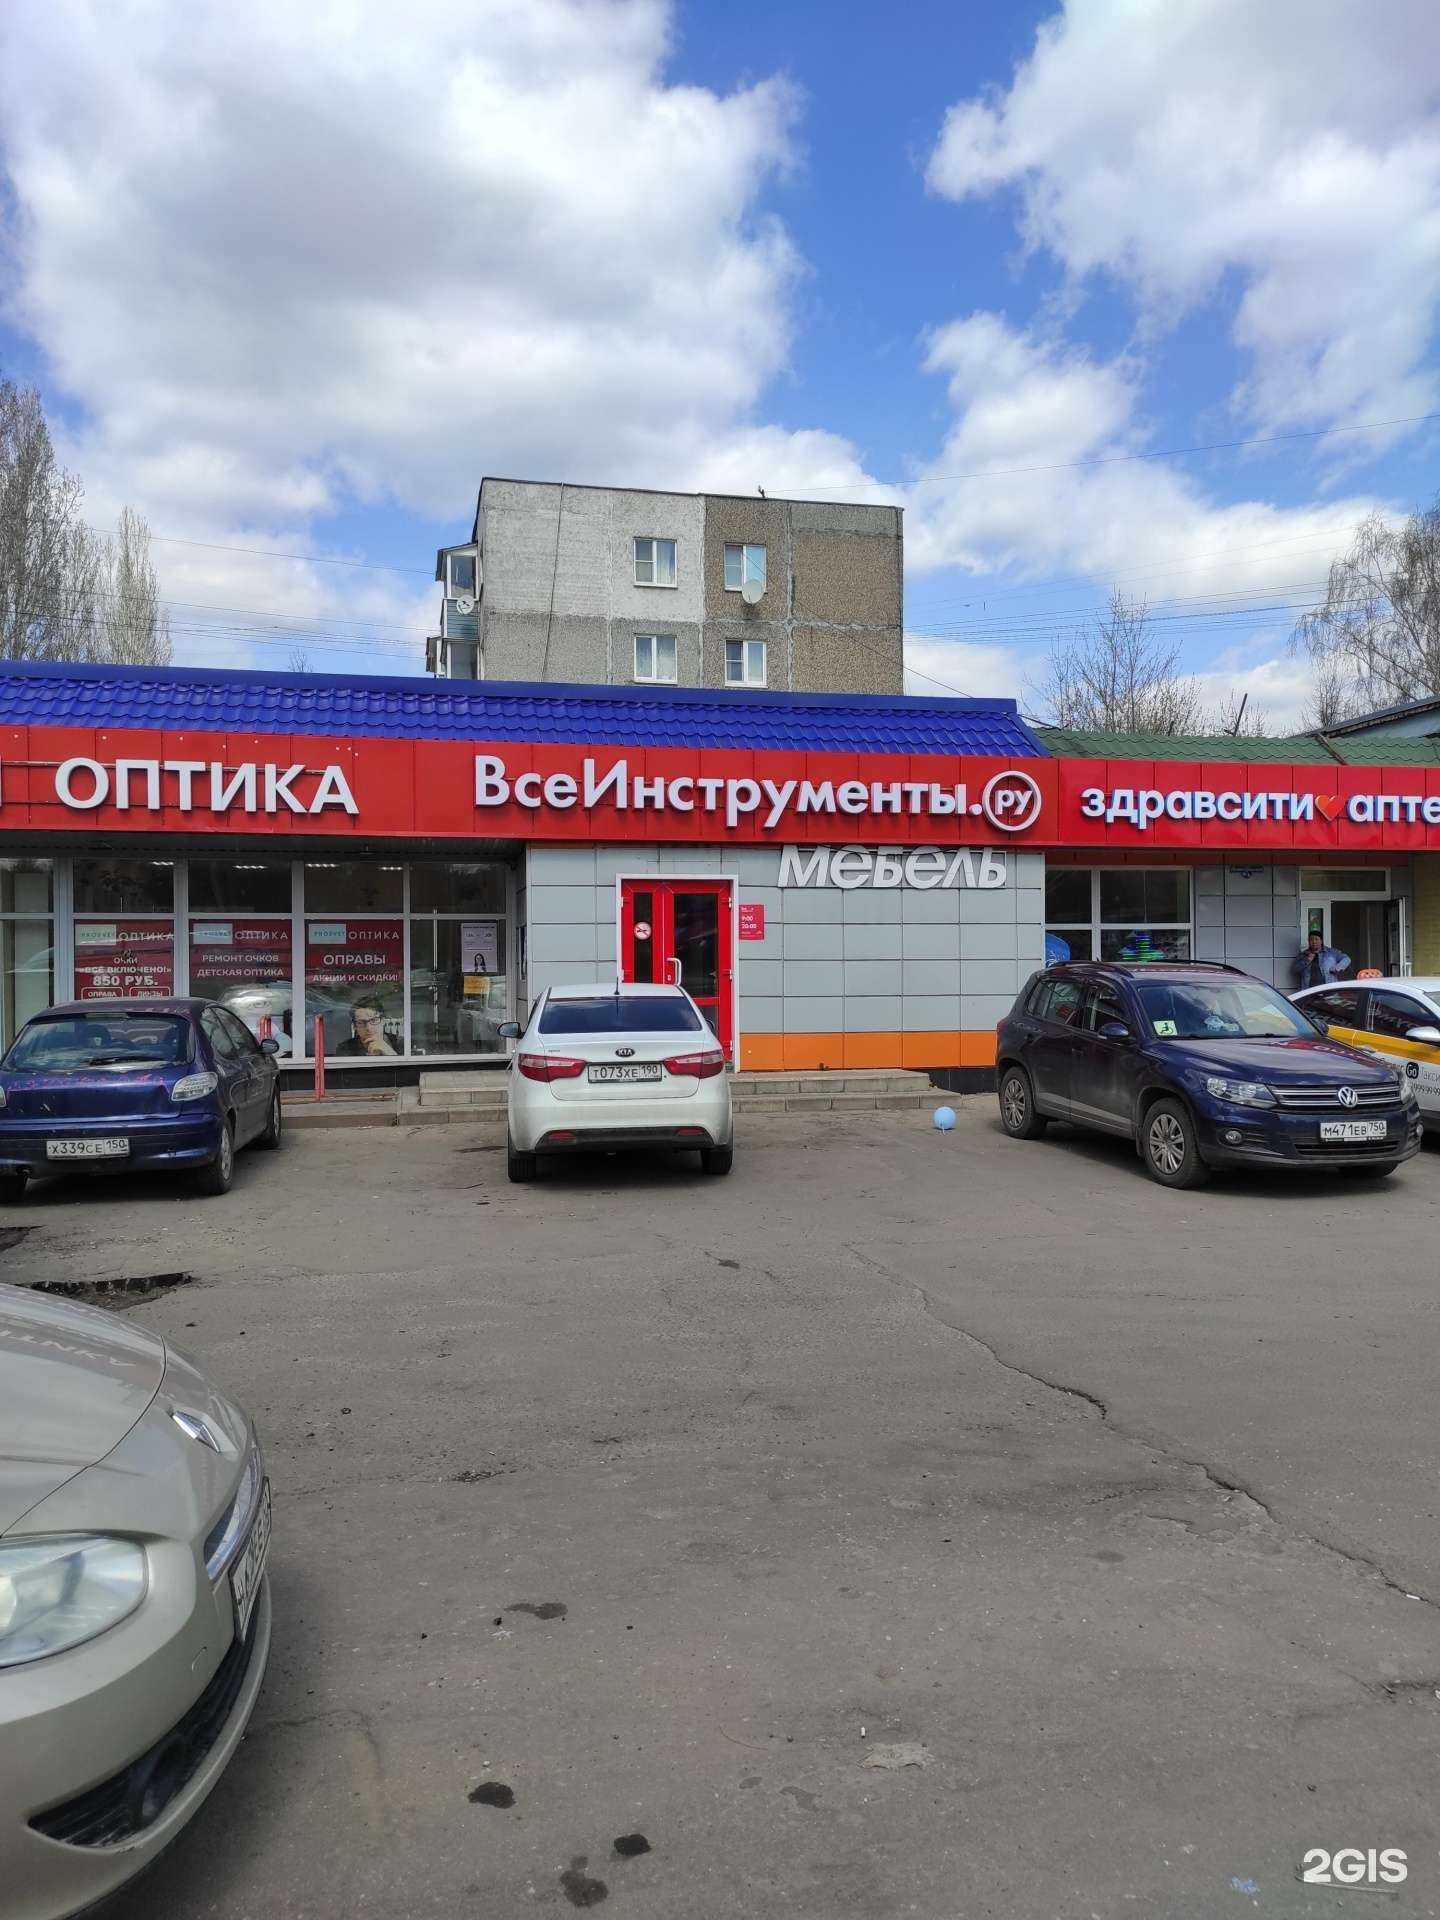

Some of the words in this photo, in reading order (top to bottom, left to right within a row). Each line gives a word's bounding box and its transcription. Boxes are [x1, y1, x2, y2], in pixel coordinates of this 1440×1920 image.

[55, 757, 359, 815] ОПТИКА
[1081, 788, 1314, 830] здравсити
[234, 931, 289, 940] ОПТИКА
[348, 931, 400, 940] ОПТИКА
[203, 954, 244, 962] РЕМОНТ
[245, 954, 279, 962] ОЧКОВ
[323, 954, 386, 966] ОПРАВЫ
[197, 968, 242, 977] ДЕТСКАЯ
[243, 968, 285, 976] ОПТИКА
[92, 975, 120, 986] 850
[124, 975, 159, 987] РУБ.
[313, 974, 347, 982] АКЦИИ
[348, 974, 355, 982] И
[357, 974, 399, 983] СКИДКИ!
[617, 1047, 633, 1056] KIA
